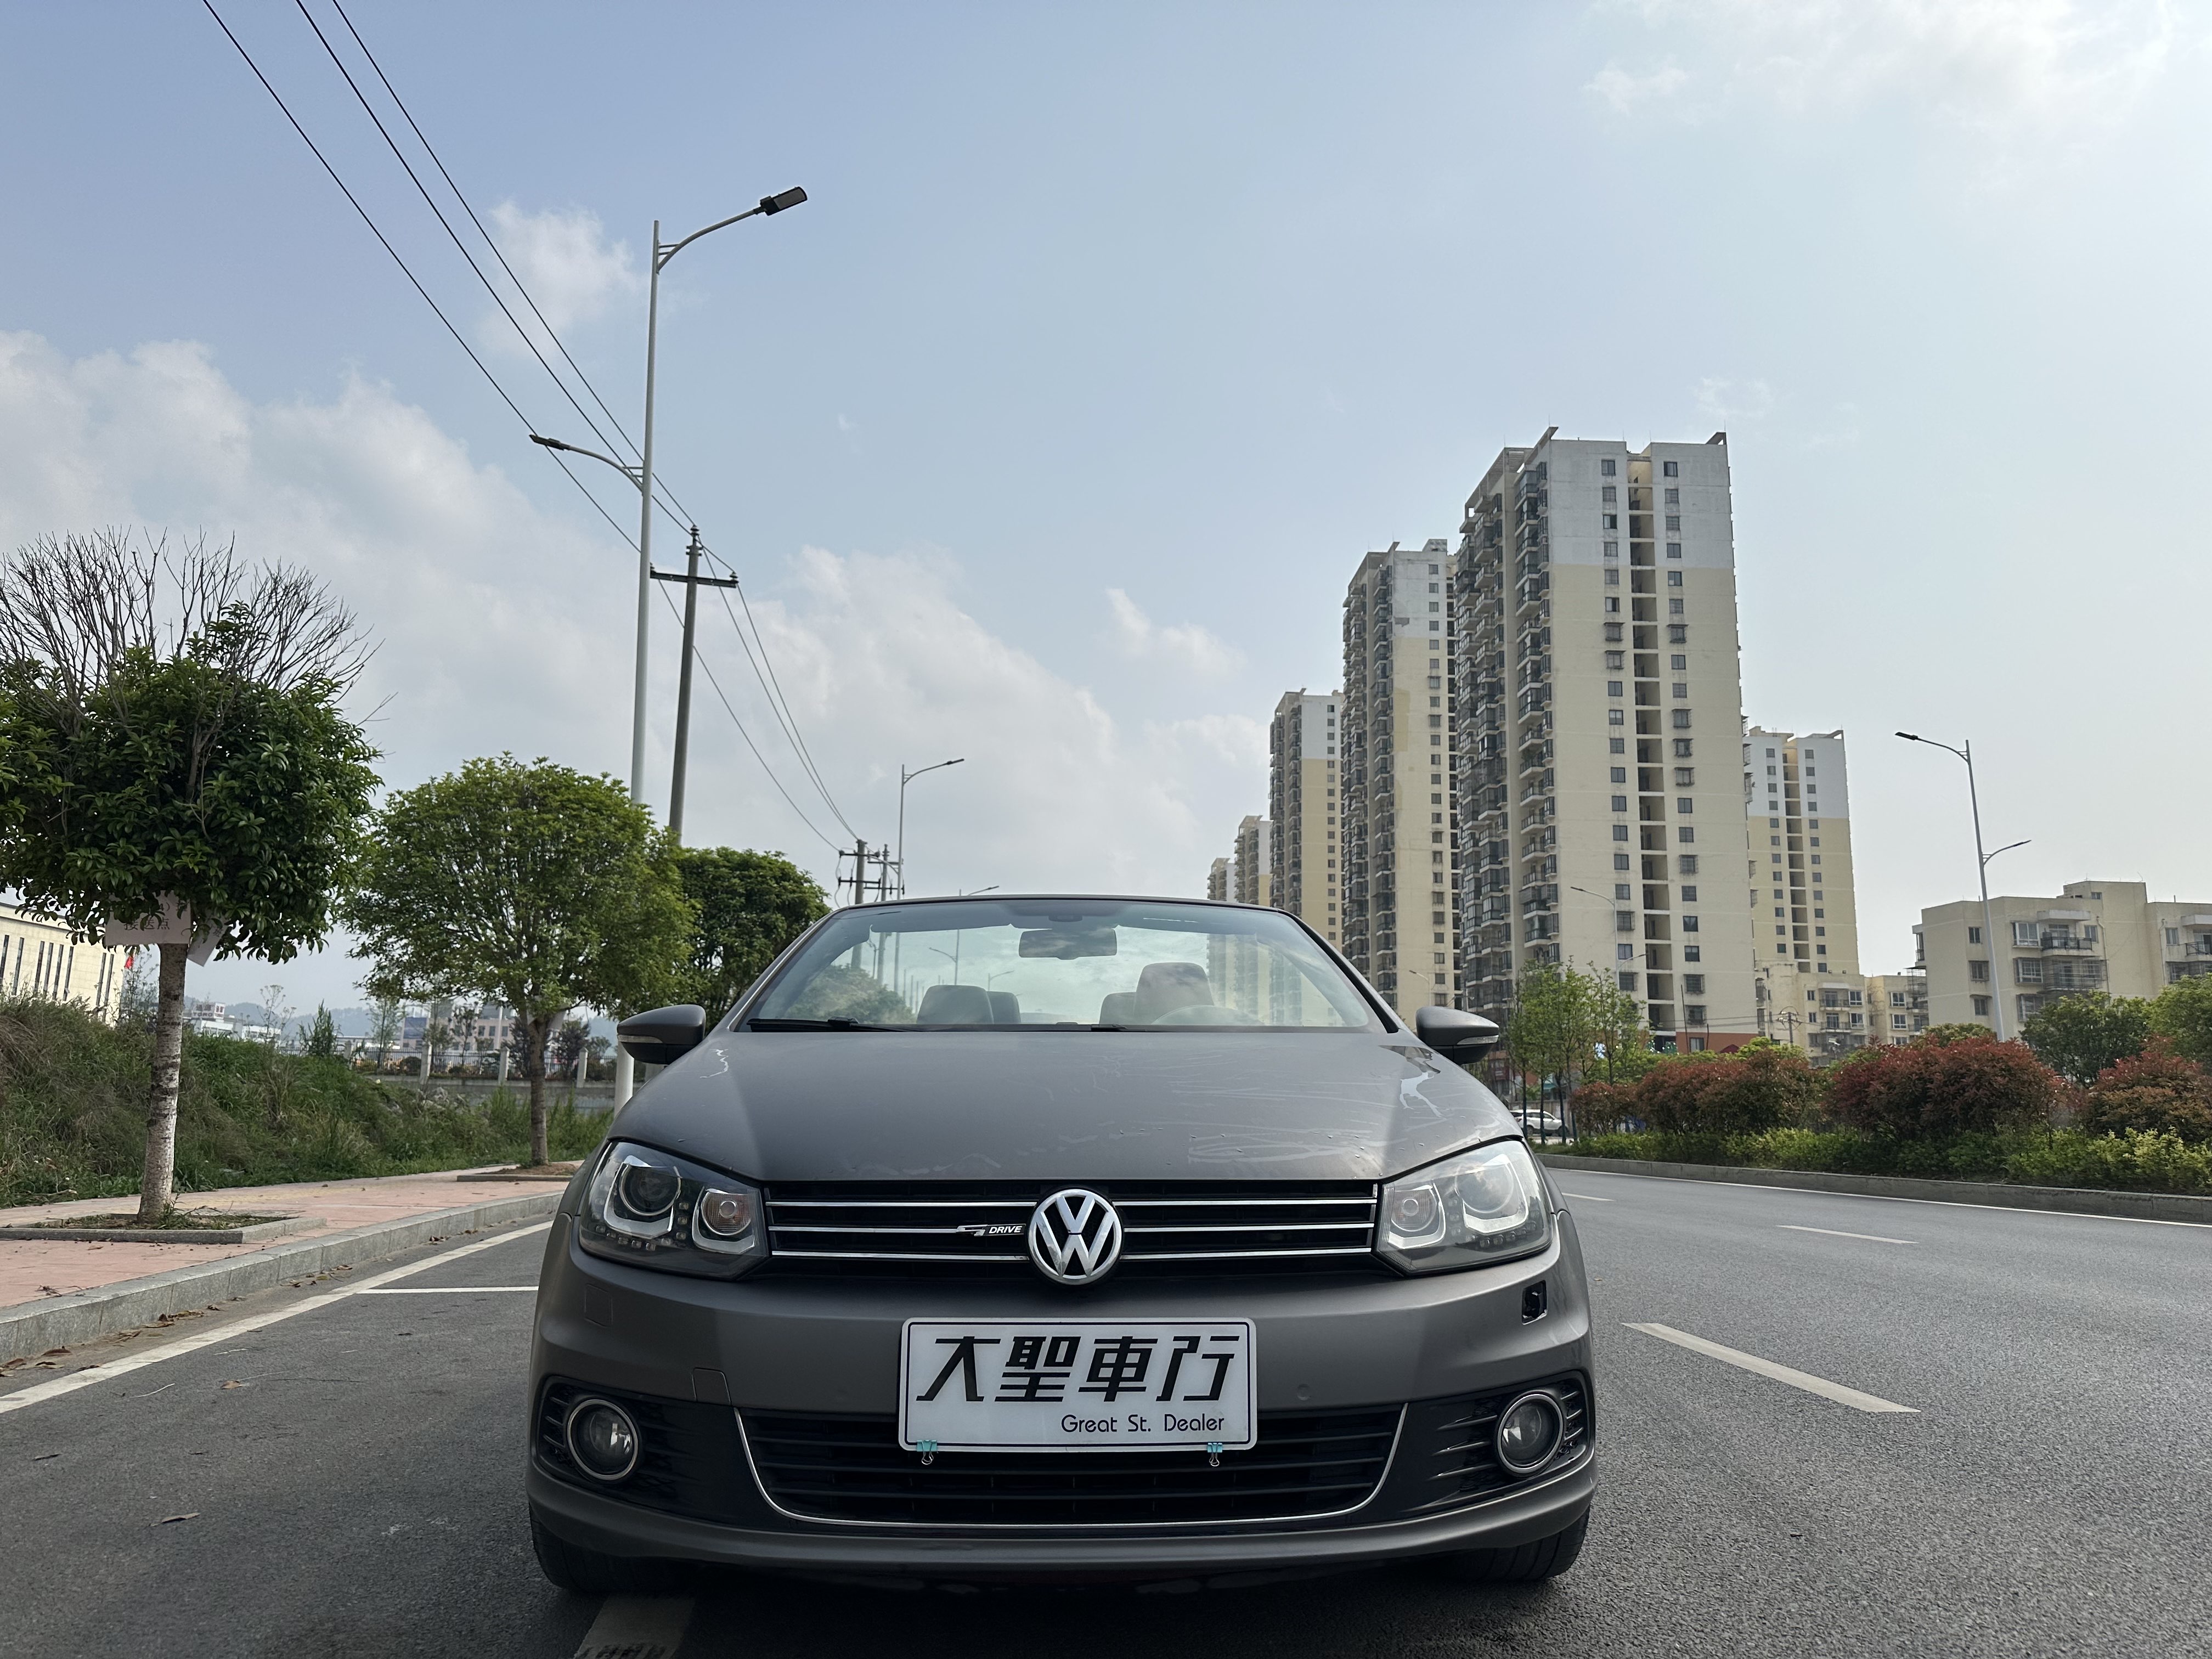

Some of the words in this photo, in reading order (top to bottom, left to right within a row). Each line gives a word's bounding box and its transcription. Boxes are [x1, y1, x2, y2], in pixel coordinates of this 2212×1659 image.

[989, 1226, 1023, 1234] DRIVE
[1062, 1415, 1117, 1432] Great
[1128, 1414, 1150, 1431] St.
[1165, 1414, 1224, 1431] Dealer
